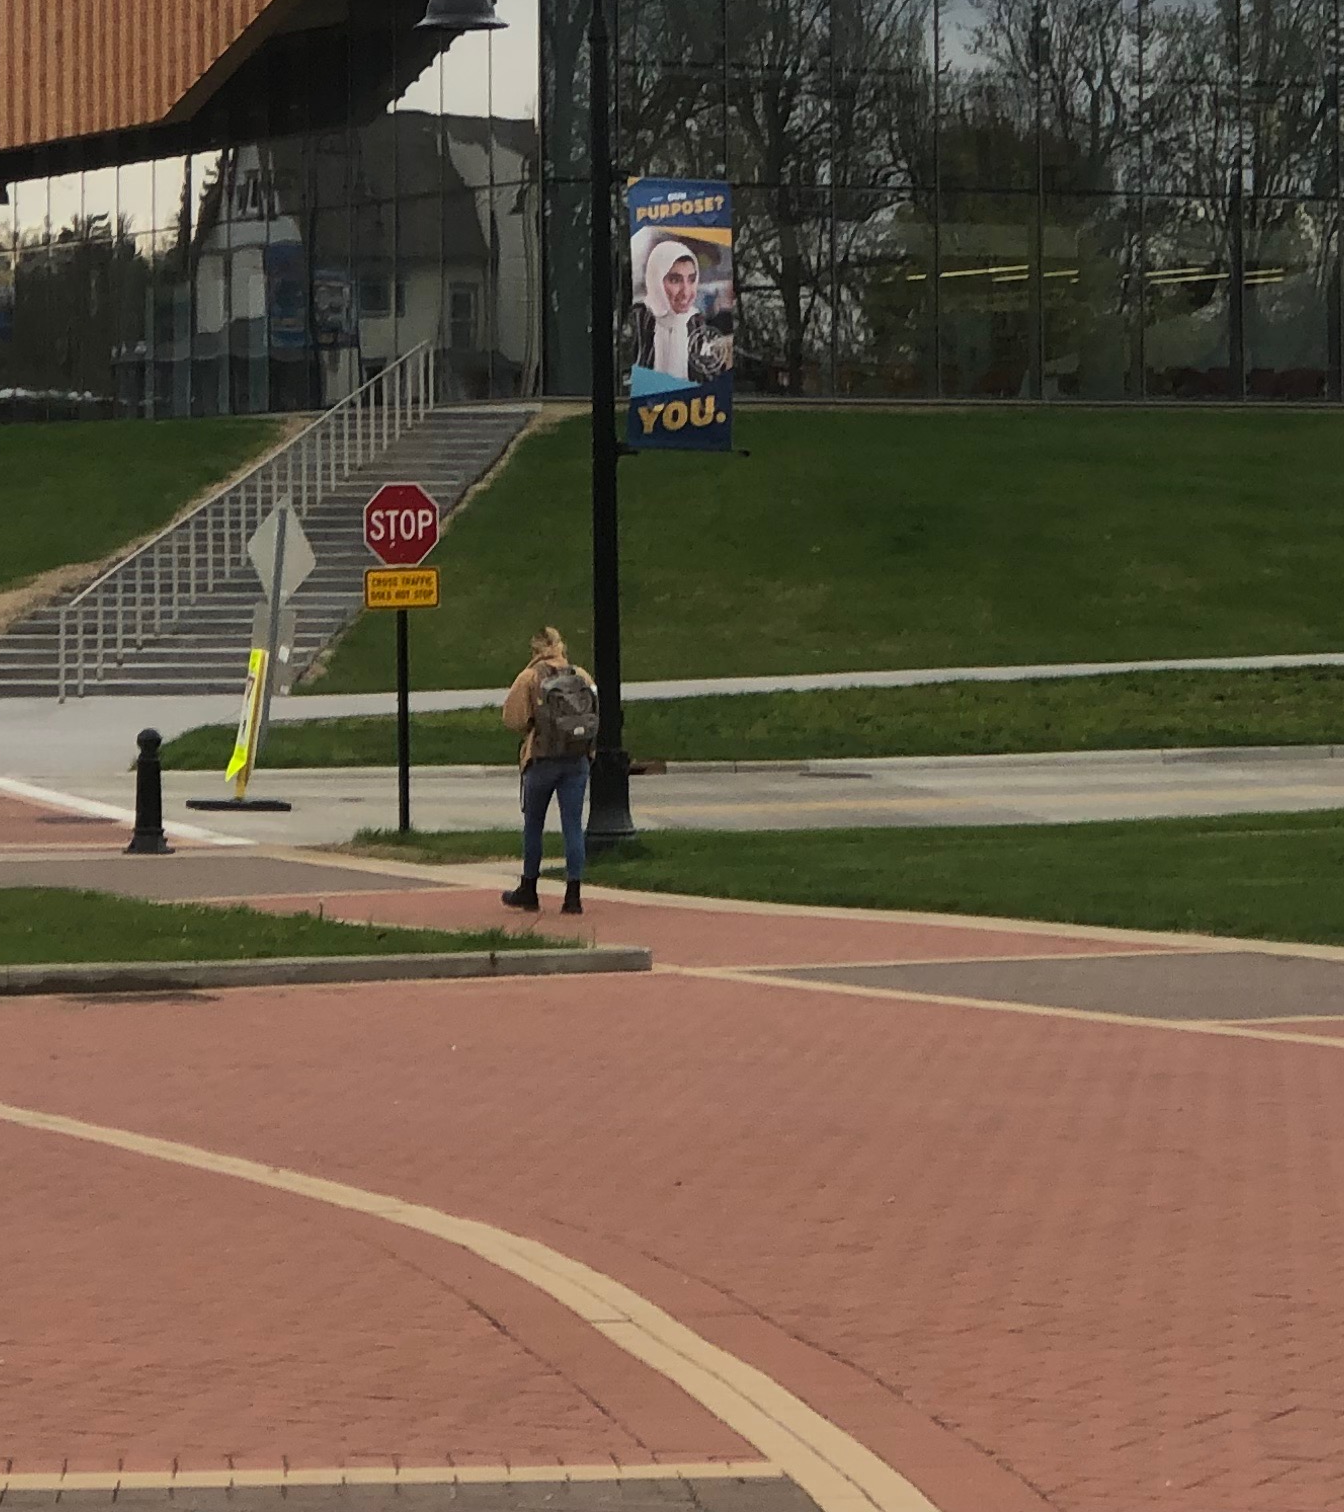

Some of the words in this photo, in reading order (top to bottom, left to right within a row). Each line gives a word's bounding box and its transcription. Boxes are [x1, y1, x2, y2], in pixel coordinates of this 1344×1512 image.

[636, 195, 724, 223] PURPOSE?
[638, 395, 727, 434] YOU.
[369, 509, 433, 541] STOP
